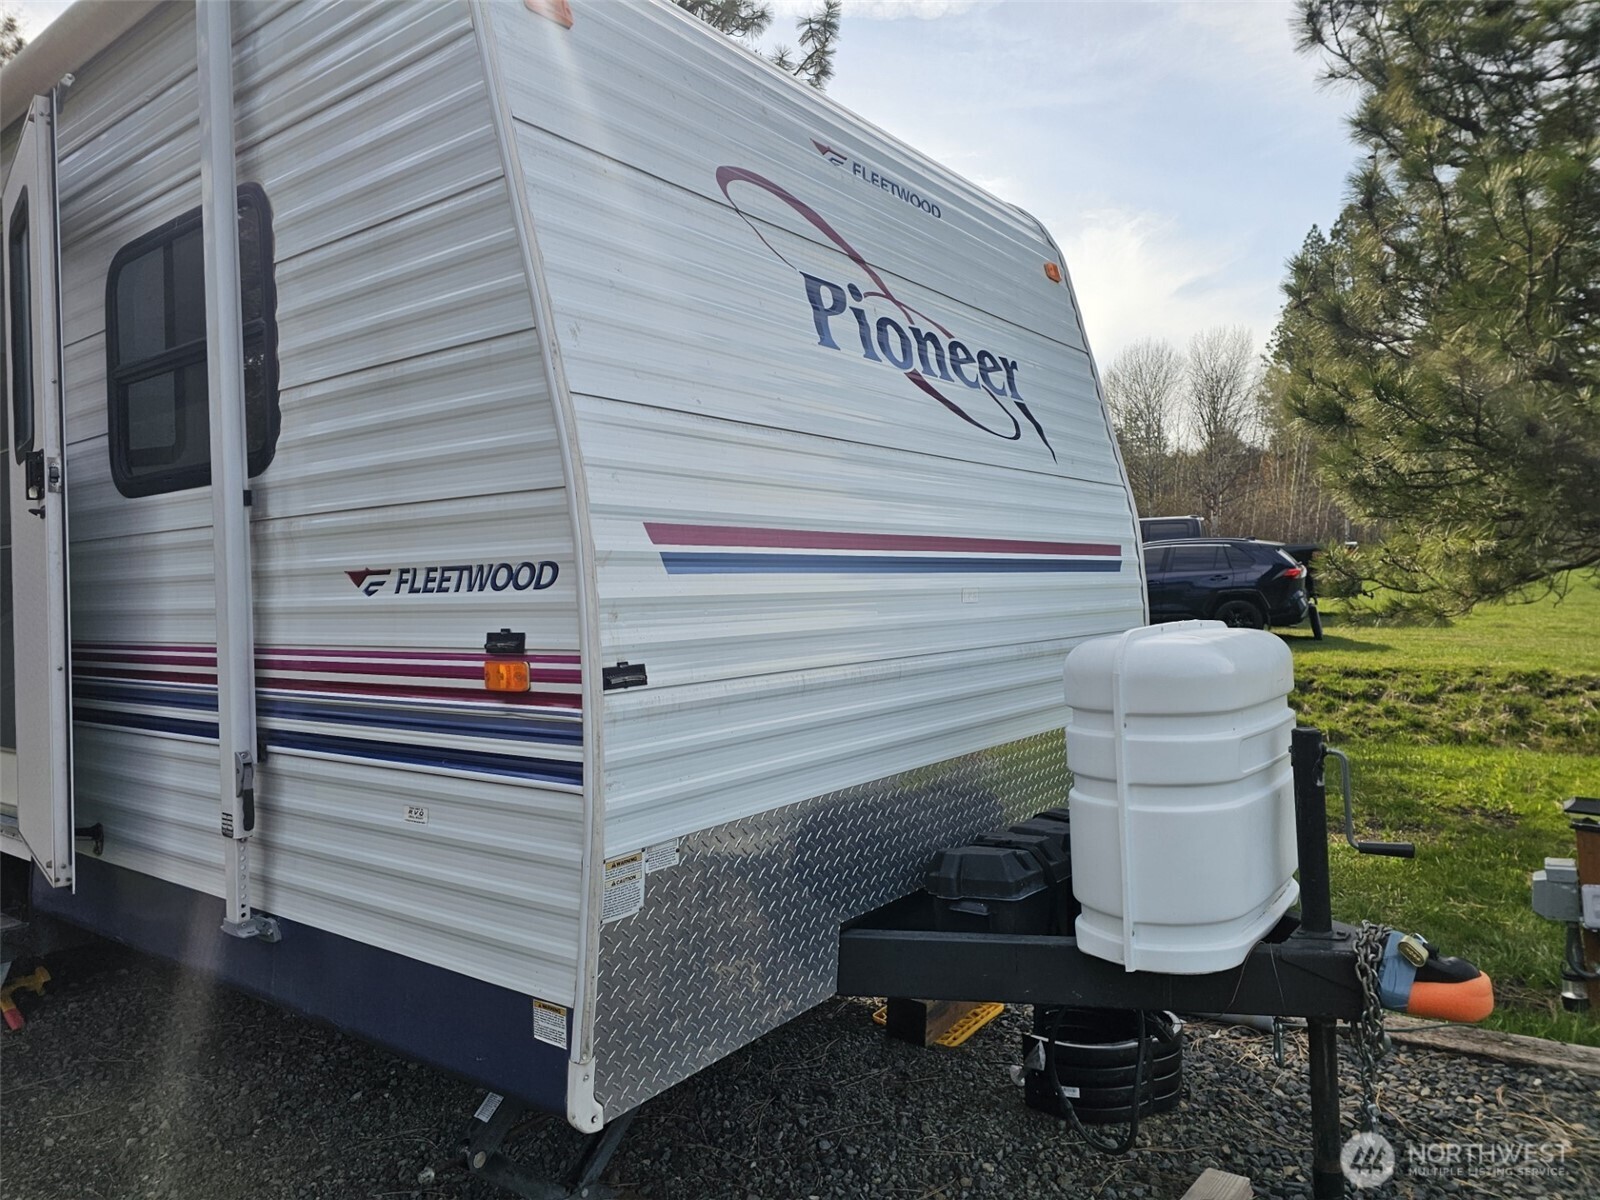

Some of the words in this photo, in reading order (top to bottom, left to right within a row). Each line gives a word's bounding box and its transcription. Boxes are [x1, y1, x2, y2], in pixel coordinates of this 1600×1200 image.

[852, 162, 942, 219] FLEETWOOD
[799, 271, 1024, 401] Pioneer
[394, 560, 559, 594] FLEETWOOD
